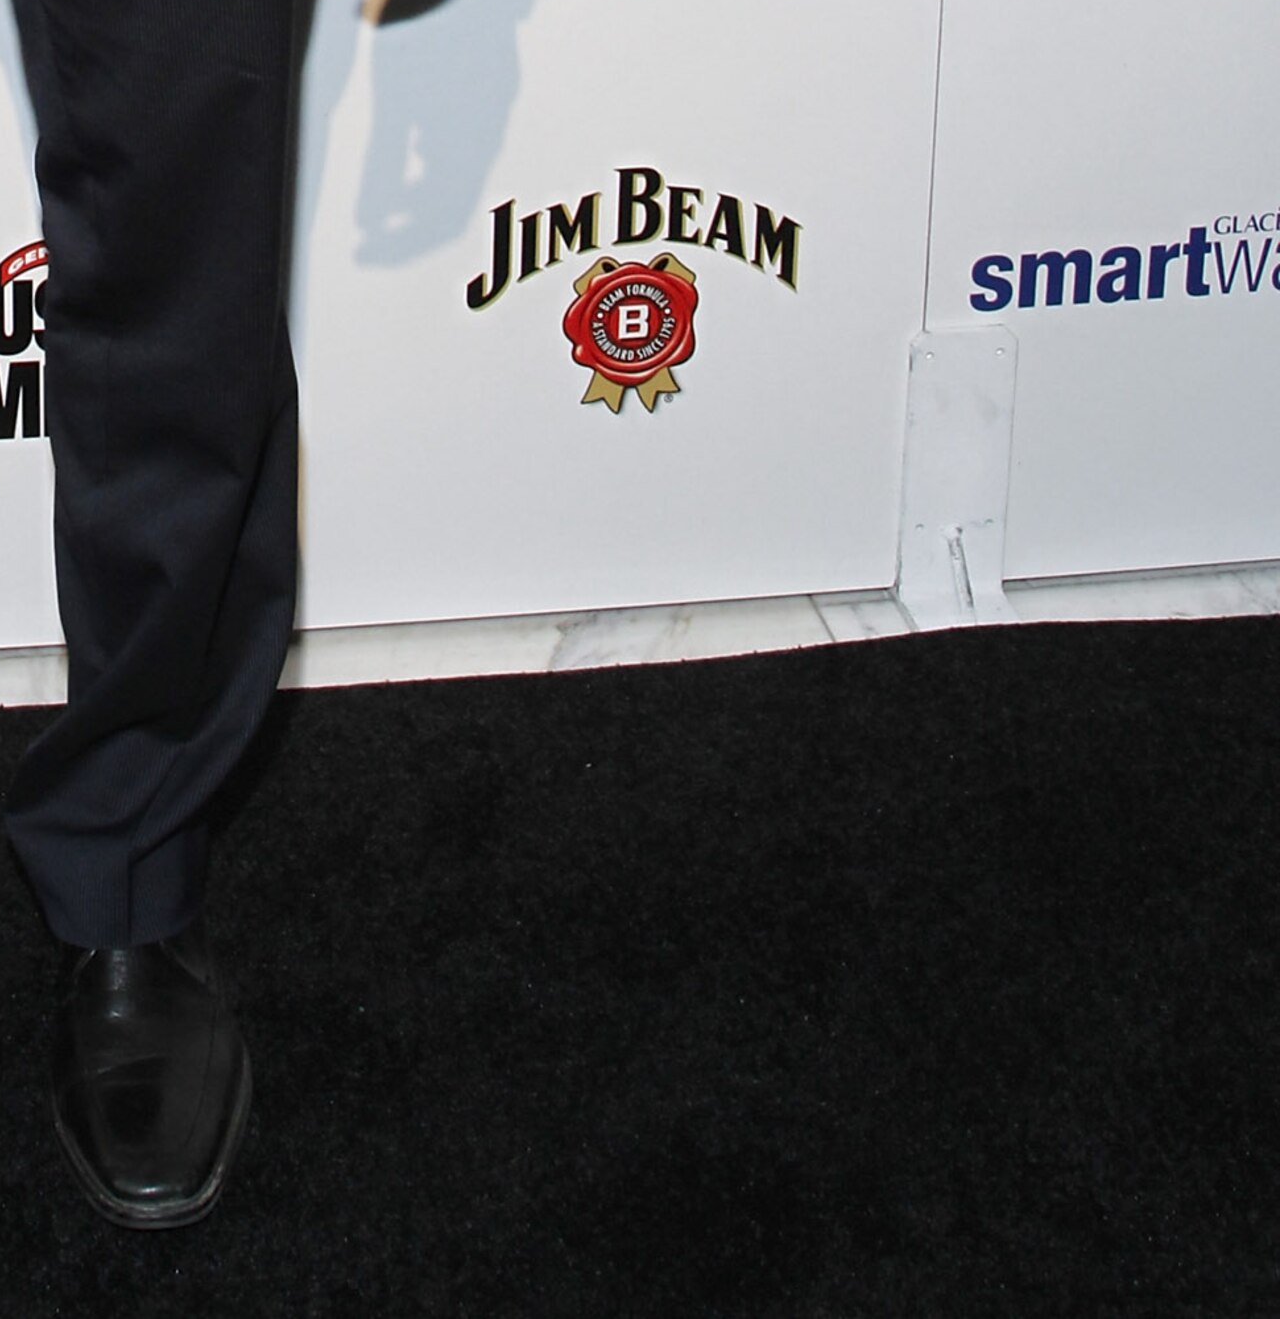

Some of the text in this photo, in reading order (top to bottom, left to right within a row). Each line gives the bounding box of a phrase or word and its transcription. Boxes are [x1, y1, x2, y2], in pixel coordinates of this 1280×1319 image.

[466, 167, 803, 312] JIM BEAM
[618, 305, 649, 340] B
